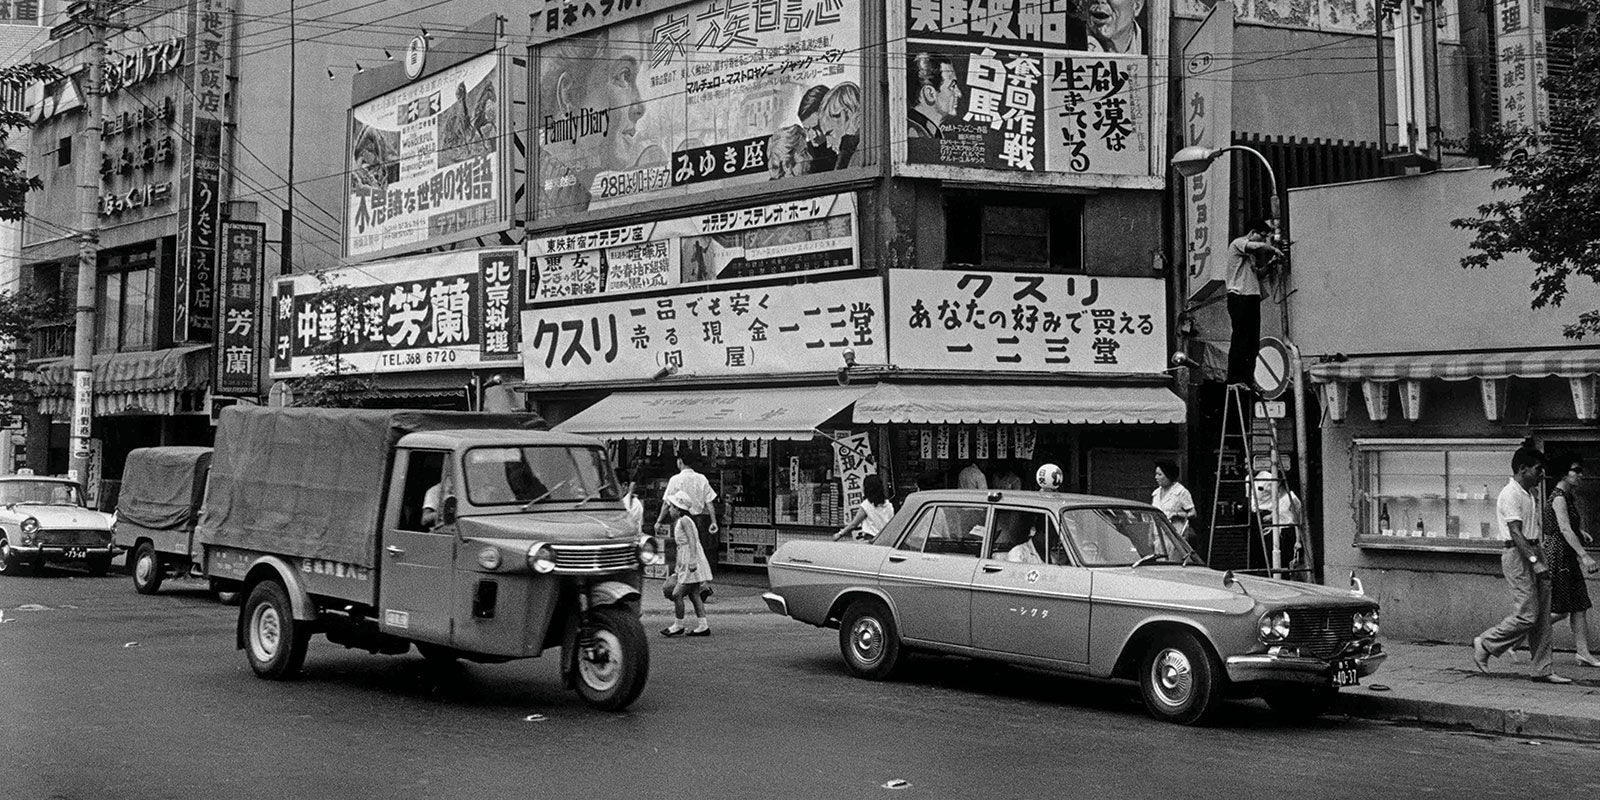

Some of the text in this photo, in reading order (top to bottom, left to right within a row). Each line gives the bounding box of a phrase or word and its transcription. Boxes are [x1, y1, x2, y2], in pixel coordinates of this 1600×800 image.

[963, 47, 1007, 130] 白馬
[999, 52, 1041, 171] 奪回作戦
[1051, 58, 1091, 172] 生きている
[1086, 60, 1132, 151] 砂漠は
[544, 107, 609, 145] Family Diary
[674, 140, 765, 182] みゆき座
[1189, 91, 1212, 280] カレショップ
[351, 155, 493, 234] 不思議な世界の物語
[231, 232, 253, 299] 中華料理
[956, 273, 1099, 306] クスリ
[278, 294, 292, 360] 餃子
[485, 261, 511, 353] 北京料理
[630, 293, 770, 320] 一品でも安く
[630, 317, 770, 349] 売る現金
[778, 302, 875, 349] 一二三堂
[908, 298, 1155, 336] あなたの好みで買える
[226, 308, 254, 375] 芳蘭
[426, 351, 457, 364] 6720
[533, 313, 617, 369] クスリ
[946, 336, 1121, 365] 一二三堂
